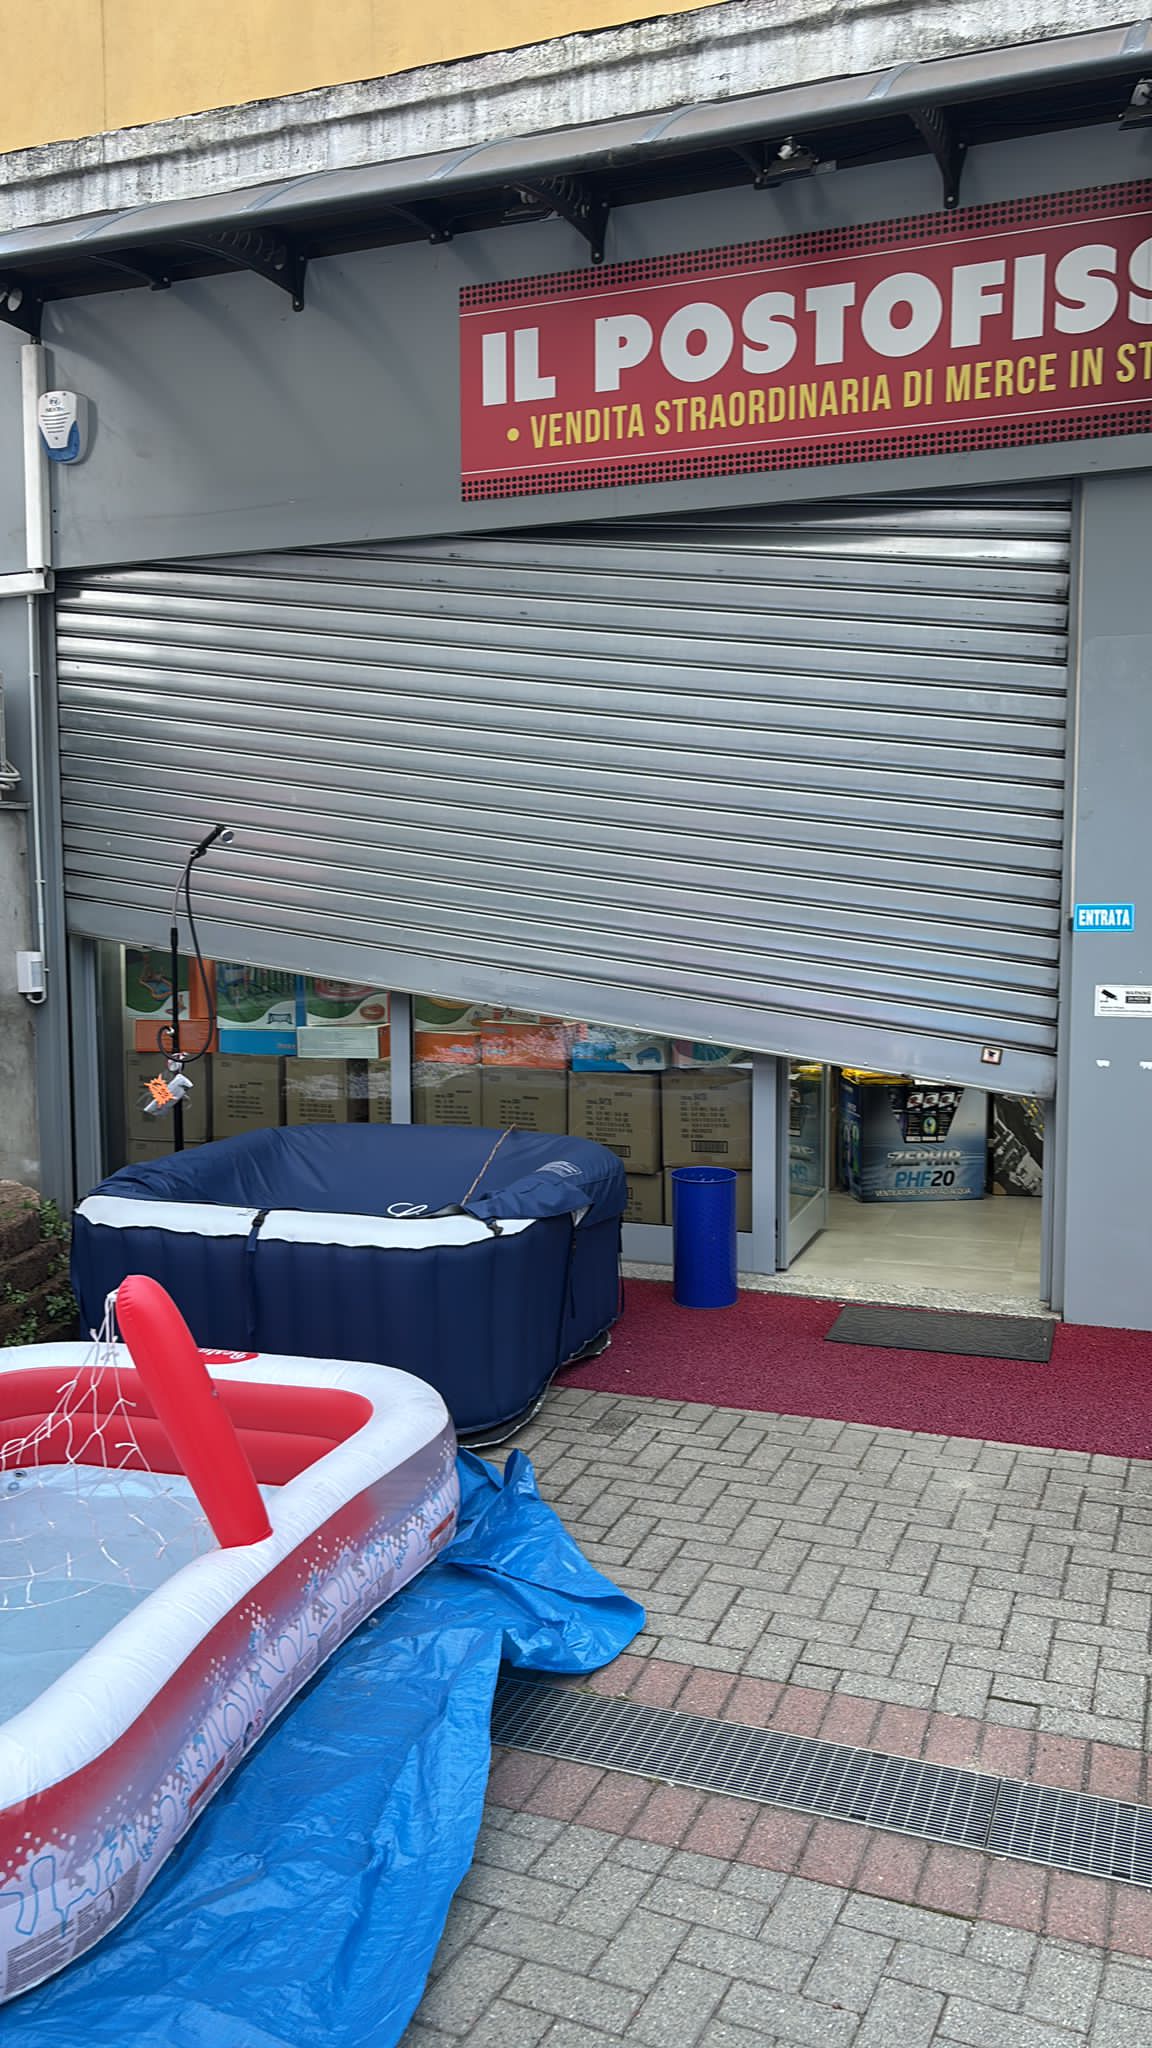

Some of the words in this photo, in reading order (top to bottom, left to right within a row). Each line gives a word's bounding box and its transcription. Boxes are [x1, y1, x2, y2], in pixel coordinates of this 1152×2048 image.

[482, 327, 556, 406] IL
[531, 403, 645, 448] VENDITA
[655, 374, 892, 435] STRAORDINARIA
[903, 368, 933, 408] DI
[945, 353, 1057, 403] MERCE
[1070, 347, 1104, 388] IN
[1116, 341, 1152, 383] ST
[1078, 909, 1131, 926] ENTRATA
[896, 1170, 955, 1187] PHF20
